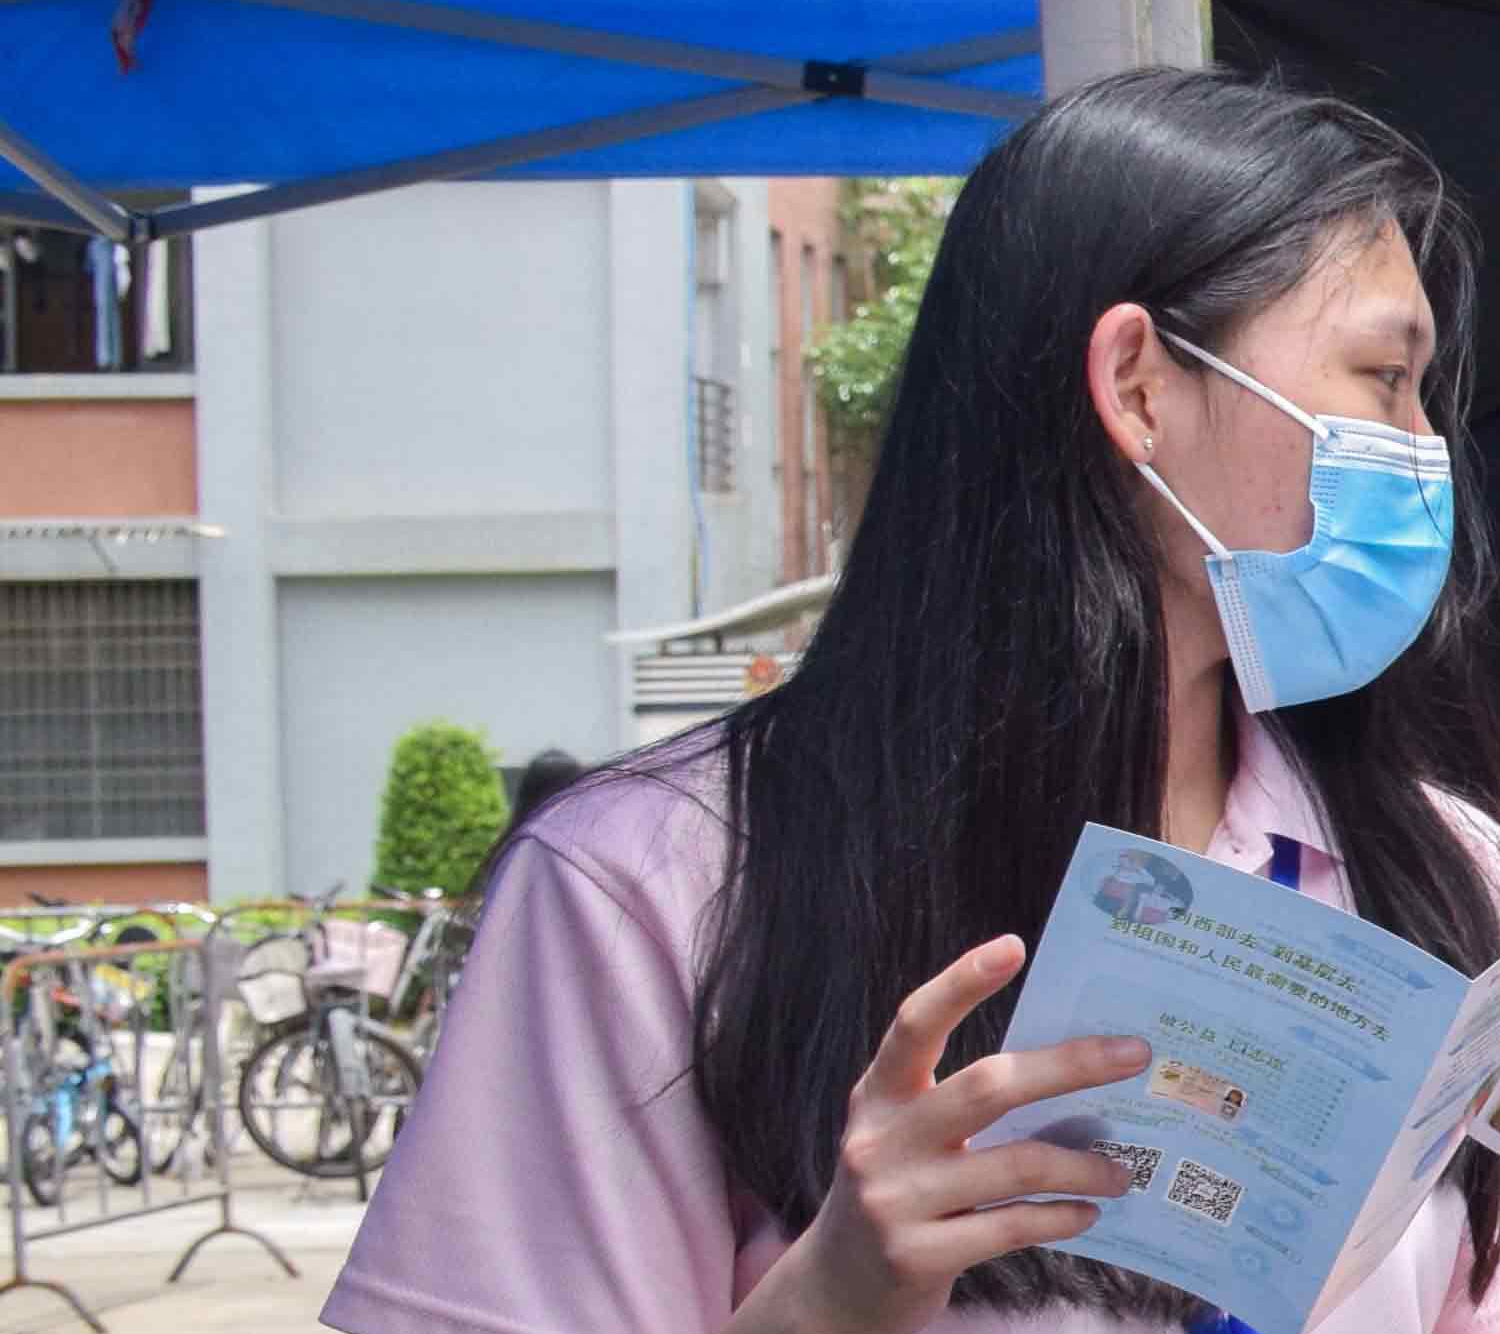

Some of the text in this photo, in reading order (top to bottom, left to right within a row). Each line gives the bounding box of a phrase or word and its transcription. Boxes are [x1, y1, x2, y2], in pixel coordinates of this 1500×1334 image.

[1111, 917, 1391, 1042] 到祖国和人民最需要的地方去
